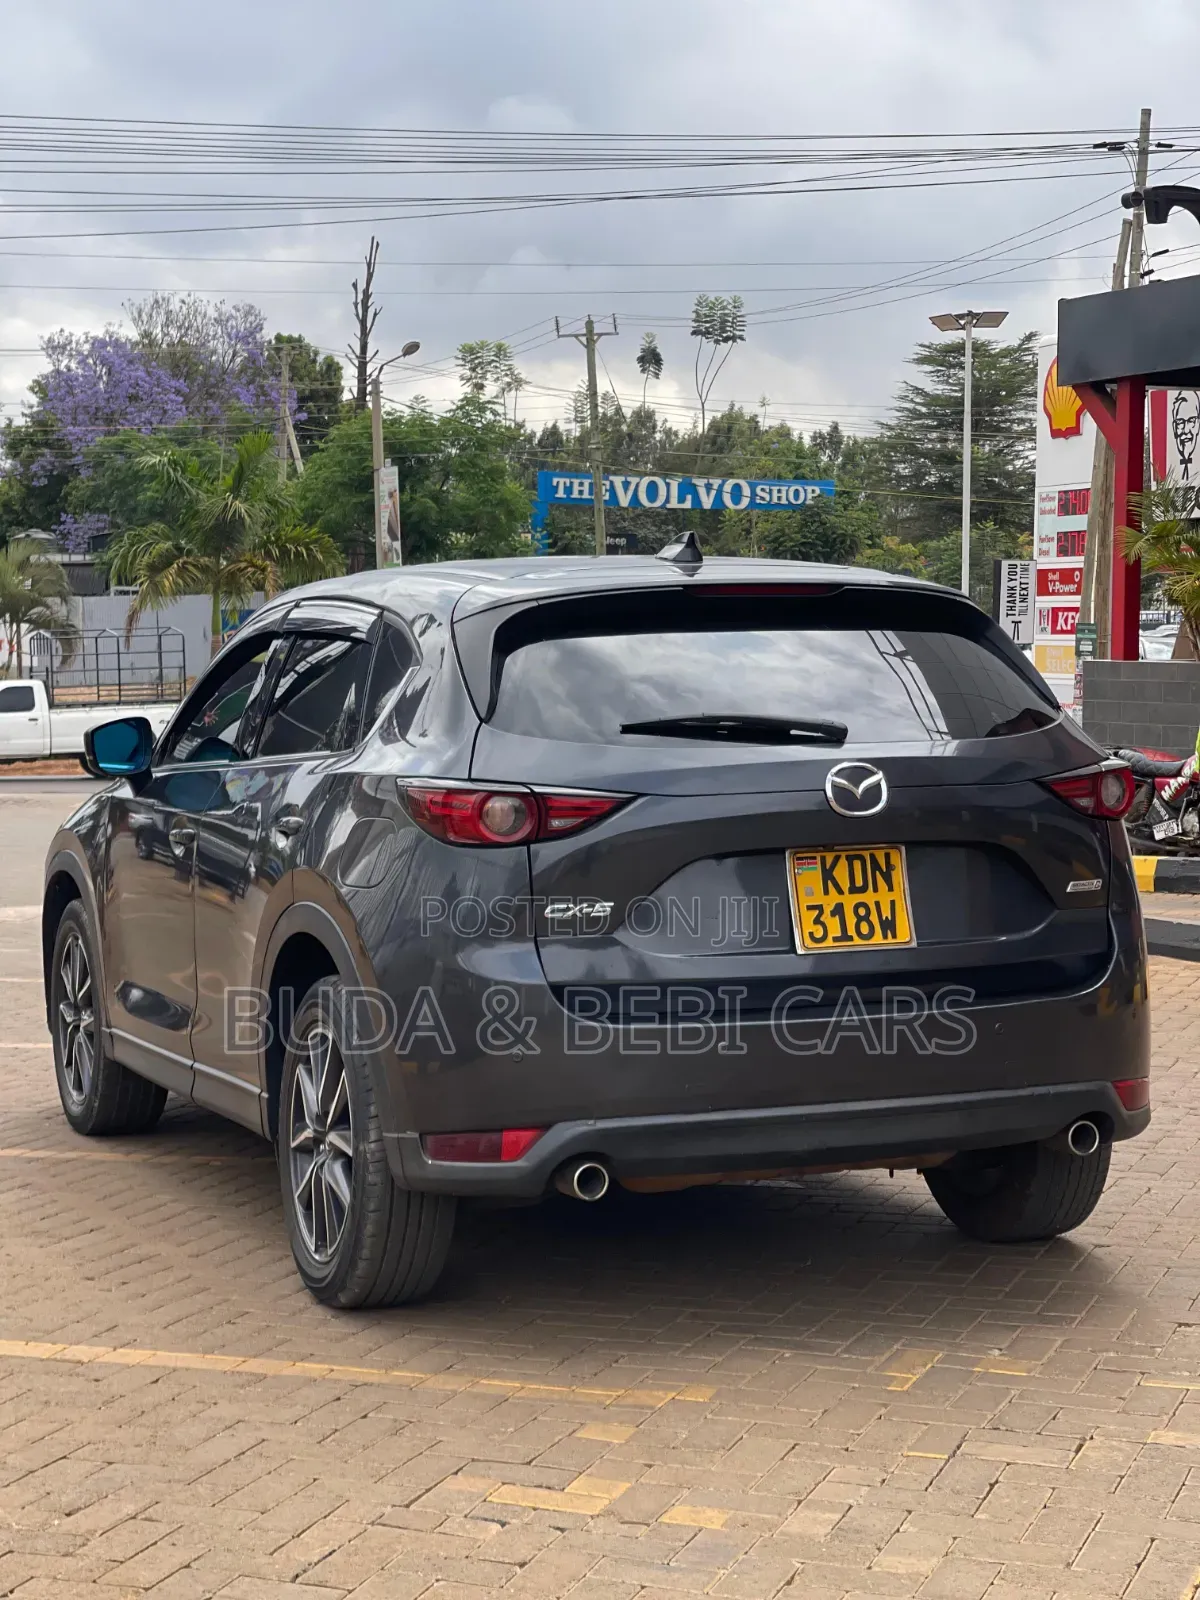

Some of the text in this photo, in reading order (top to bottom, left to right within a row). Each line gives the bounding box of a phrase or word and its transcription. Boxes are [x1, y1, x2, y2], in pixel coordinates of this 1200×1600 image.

[552, 476, 820, 510] THE VOLVO SHOP
[1006, 563, 1018, 618] THANK YOU
[1018, 562, 1030, 617] TILL NEXT TIME
[1047, 571, 1060, 581] Shell
[1048, 580, 1078, 593] V-Power
[819, 852, 894, 896] KDN
[544, 901, 614, 918] CX-5
[806, 899, 897, 944] 318W
